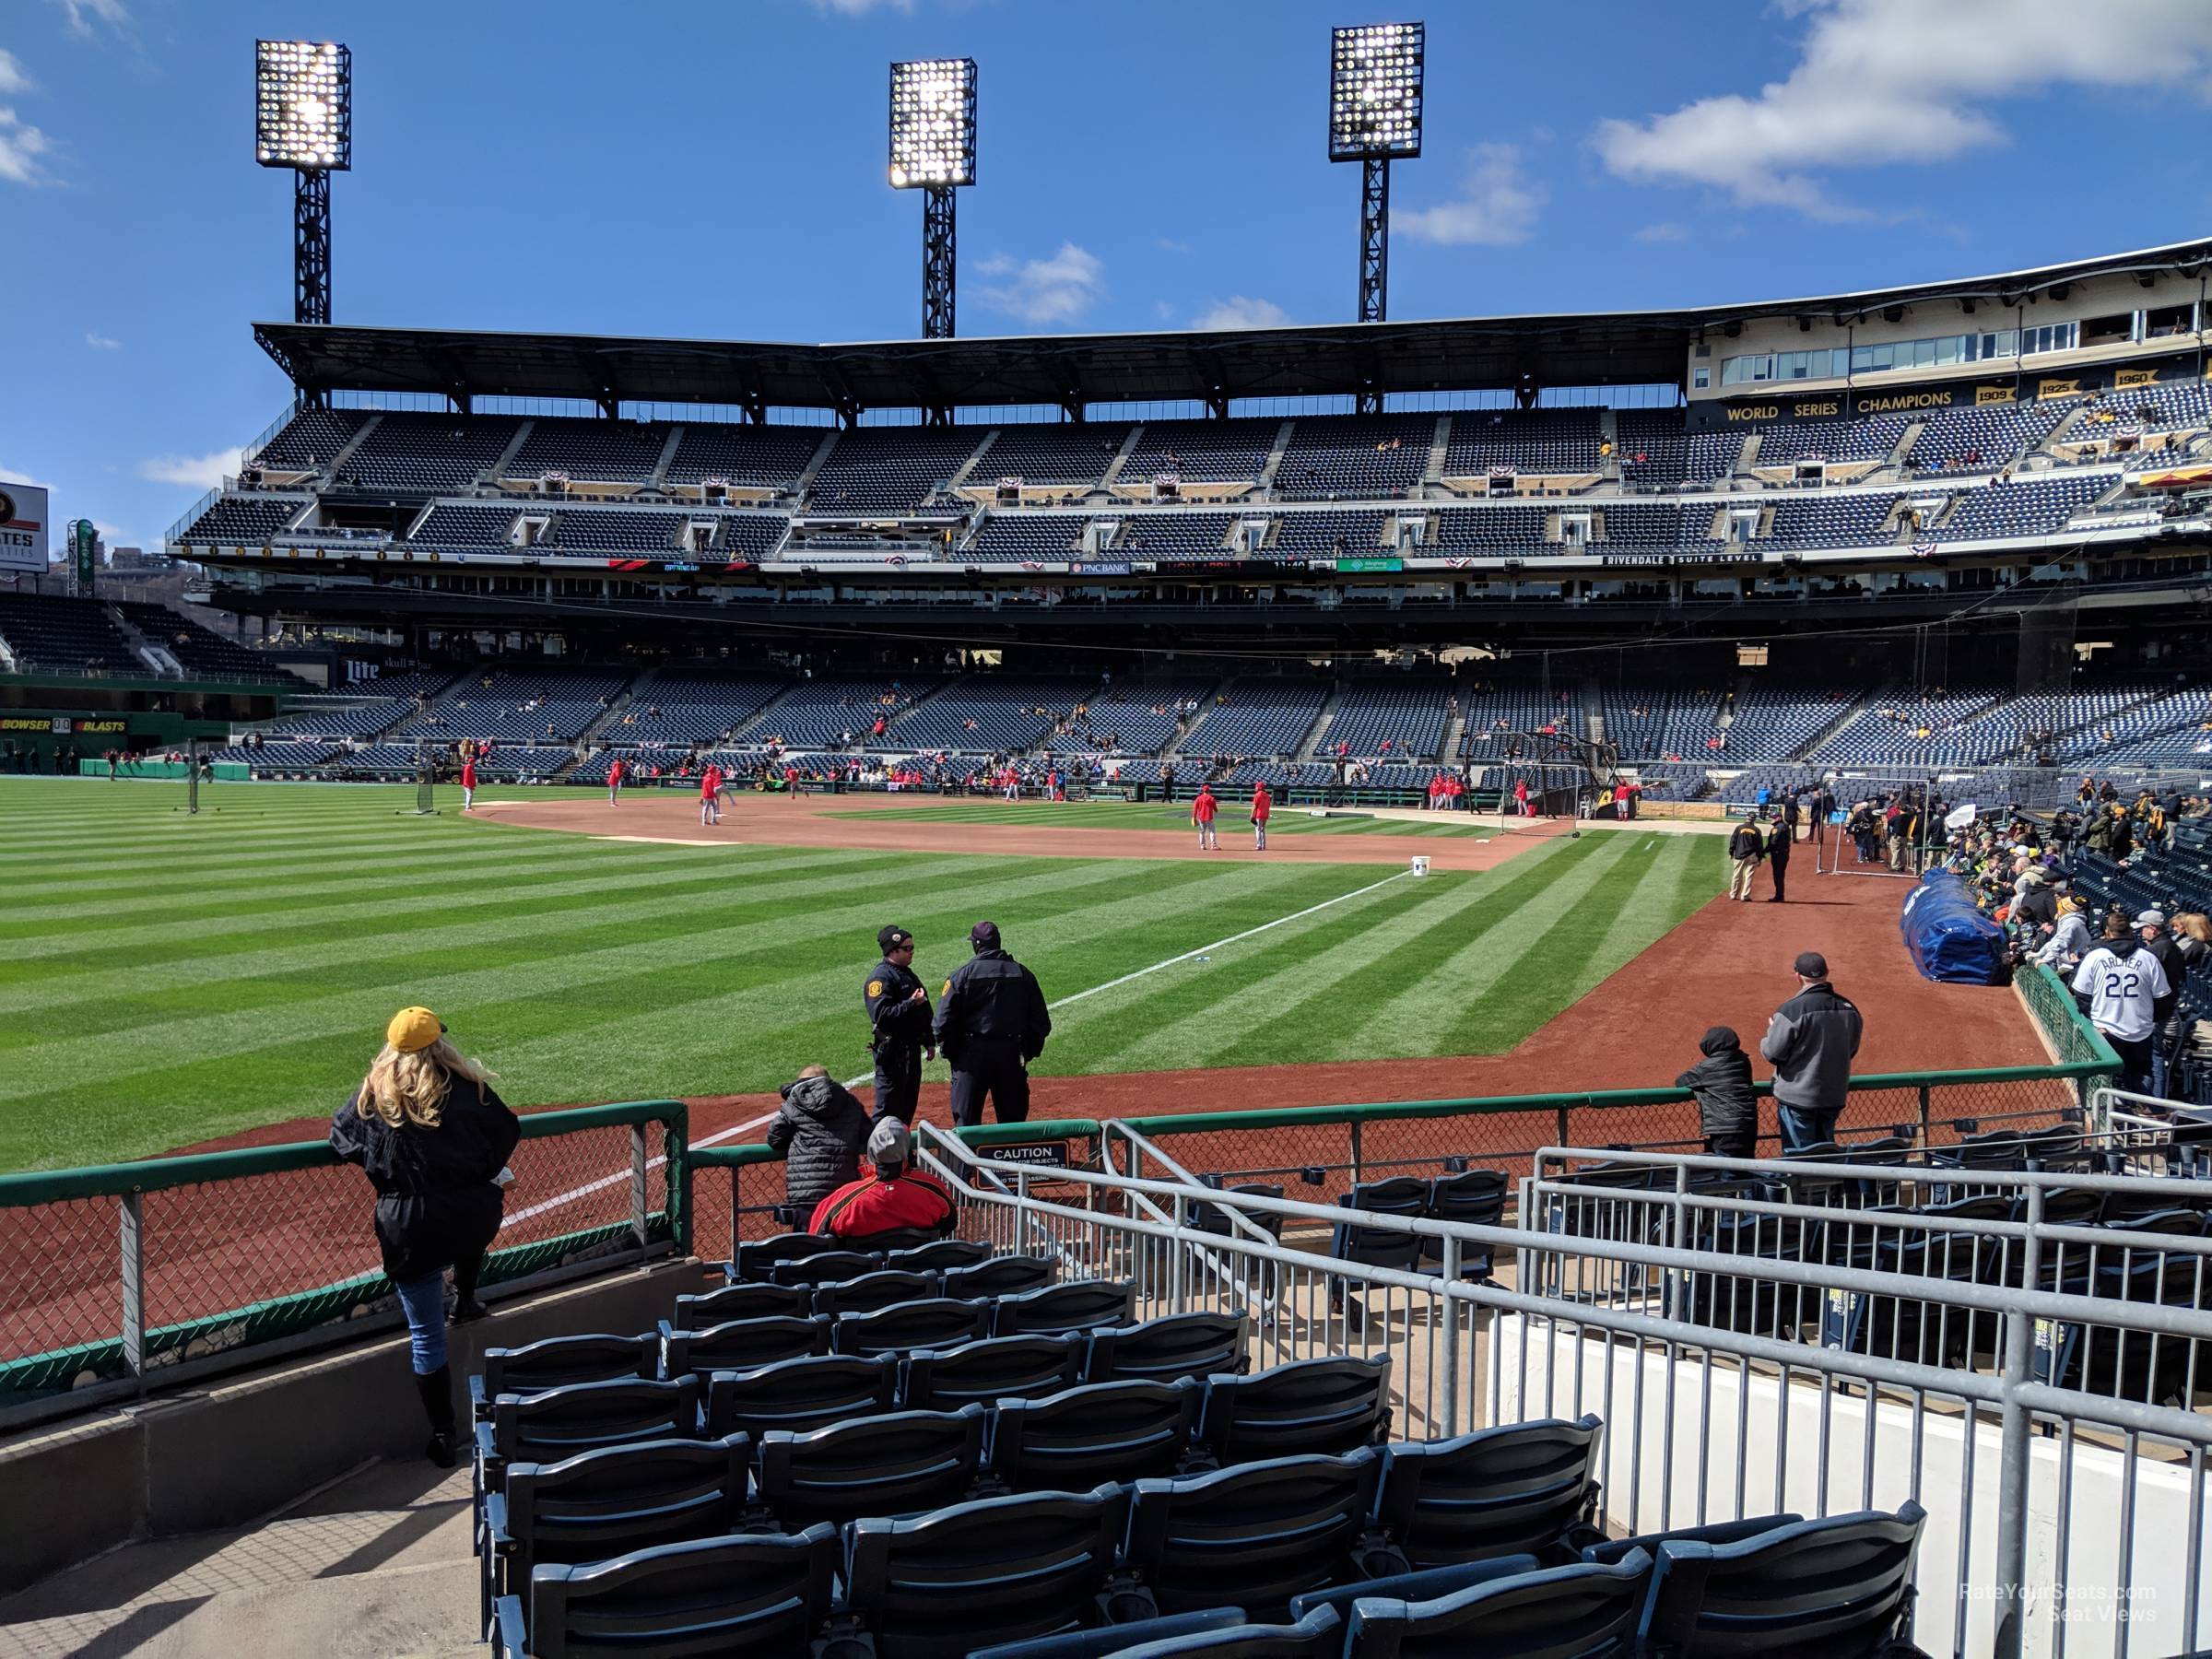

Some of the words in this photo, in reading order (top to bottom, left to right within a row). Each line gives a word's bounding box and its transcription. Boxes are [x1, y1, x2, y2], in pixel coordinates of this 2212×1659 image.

[2119, 372, 2148, 384] 1960
[2041, 382, 2071, 394] 1925
[1979, 390, 2007, 402] 1909
[1727, 406, 1779, 421] WORLD
[1794, 402, 1839, 417] SERIES
[1857, 392, 1952, 413] CHAMPIONS
[1607, 556, 1665, 565] RIVENDALE
[1678, 555, 1714, 563] SUITE
[1720, 554, 1759, 562] LEVEL
[1083, 564, 1101, 572] PNC
[1102, 563, 1125, 572] BANK
[347, 660, 379, 685] Lite
[2, 719, 51, 730] BOWSER
[83, 721, 125, 732] BLASTS
[2105, 973, 2140, 998] 22
[994, 1147, 1053, 1159] CAUTION
